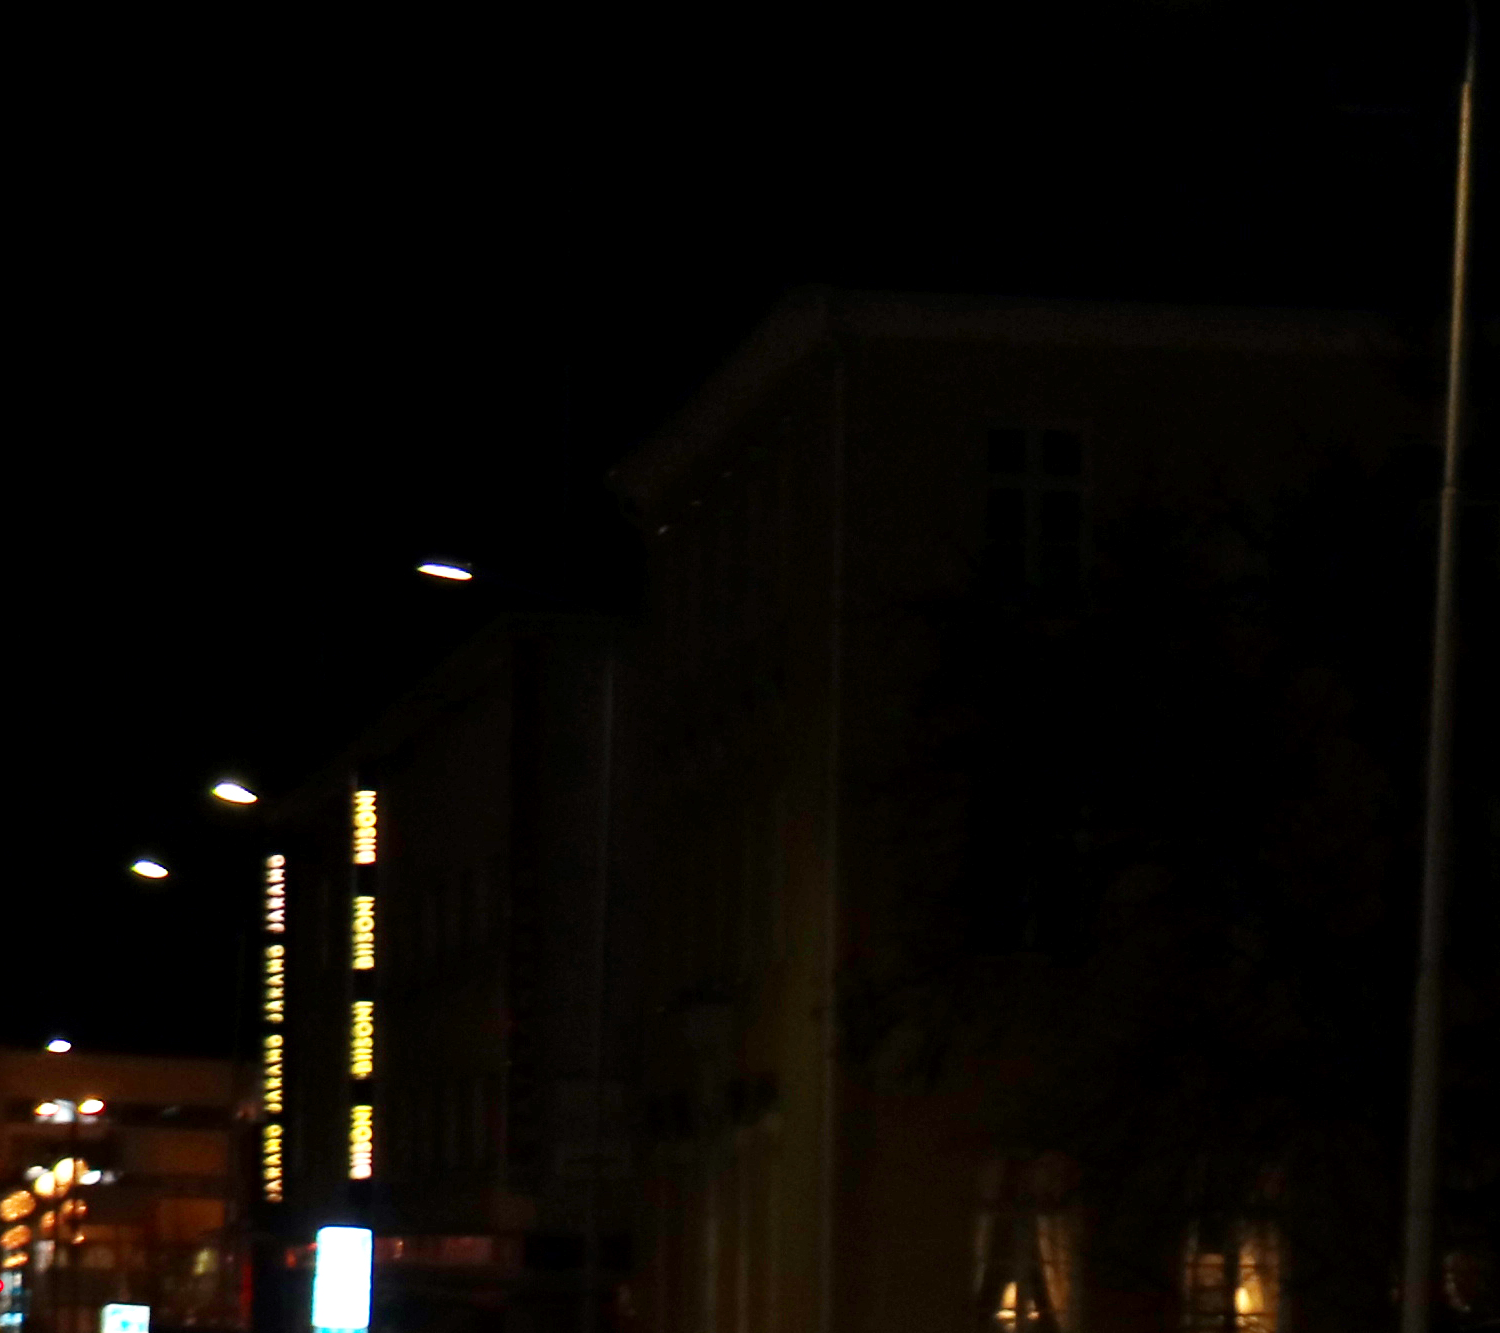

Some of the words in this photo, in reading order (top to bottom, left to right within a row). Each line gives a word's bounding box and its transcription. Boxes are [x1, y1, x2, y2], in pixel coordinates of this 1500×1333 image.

[352, 790, 377, 864] BIISONI
[351, 896, 375, 970] BIISONI
[350, 1001, 374, 1075] BIISONI
[349, 1105, 373, 1180] BIISONI
